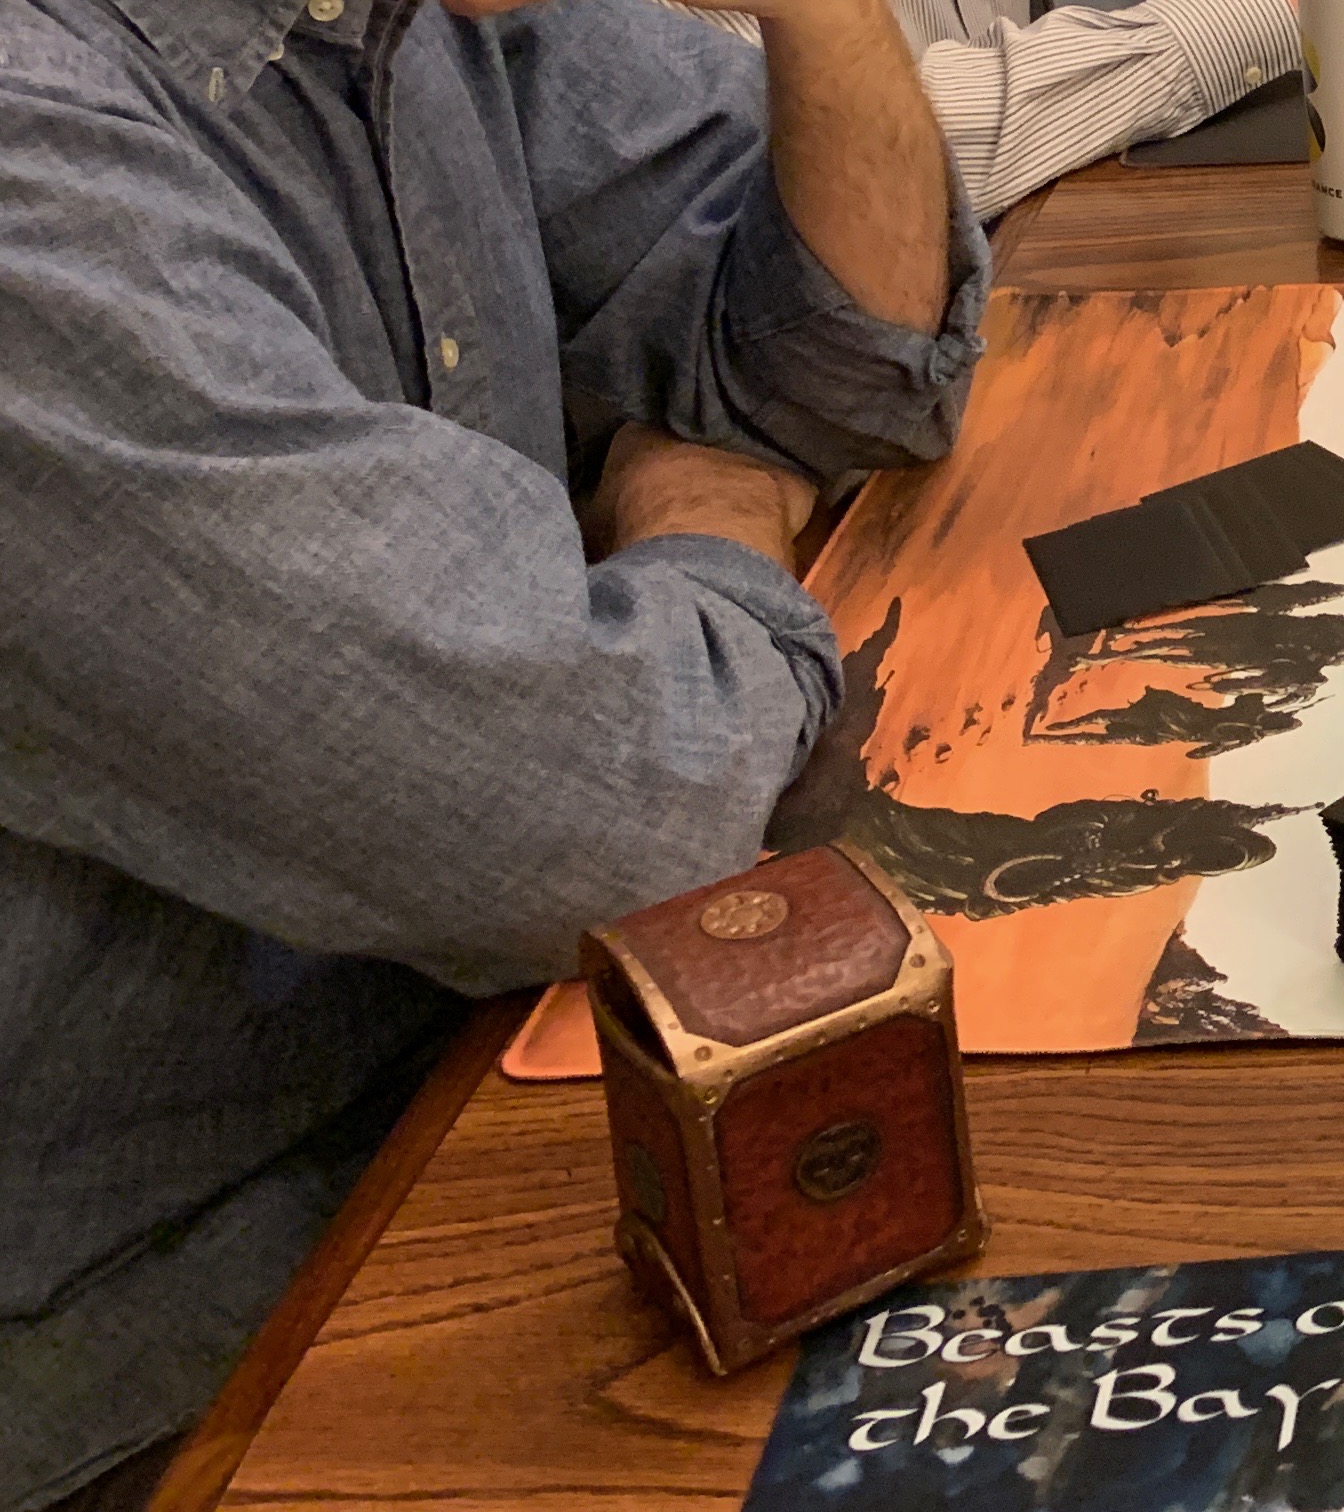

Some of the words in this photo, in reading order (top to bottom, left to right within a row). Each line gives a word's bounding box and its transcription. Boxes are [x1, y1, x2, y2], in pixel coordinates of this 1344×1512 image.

[856, 1304, 1265, 1369] Beasts
[848, 1381, 1051, 1452] the
[1090, 1363, 1341, 1452] Bay
